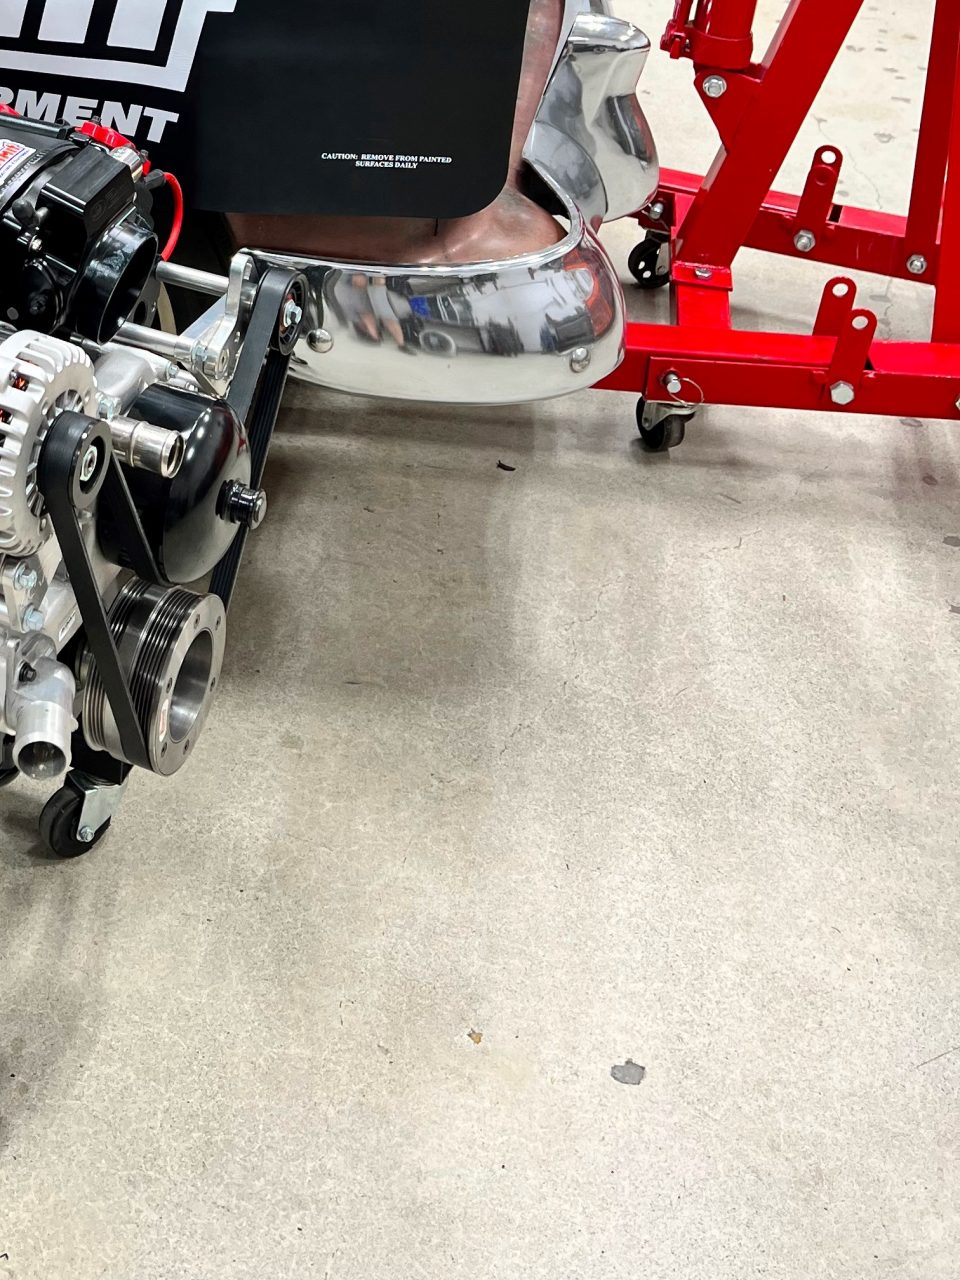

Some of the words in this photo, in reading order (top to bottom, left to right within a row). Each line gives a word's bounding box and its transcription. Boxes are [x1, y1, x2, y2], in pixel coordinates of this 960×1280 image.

[321, 152, 358, 160] CAUTION:
[361, 153, 394, 161] REMOVE
[395, 154, 418, 162] FROM
[355, 160, 394, 168] SURFACES
